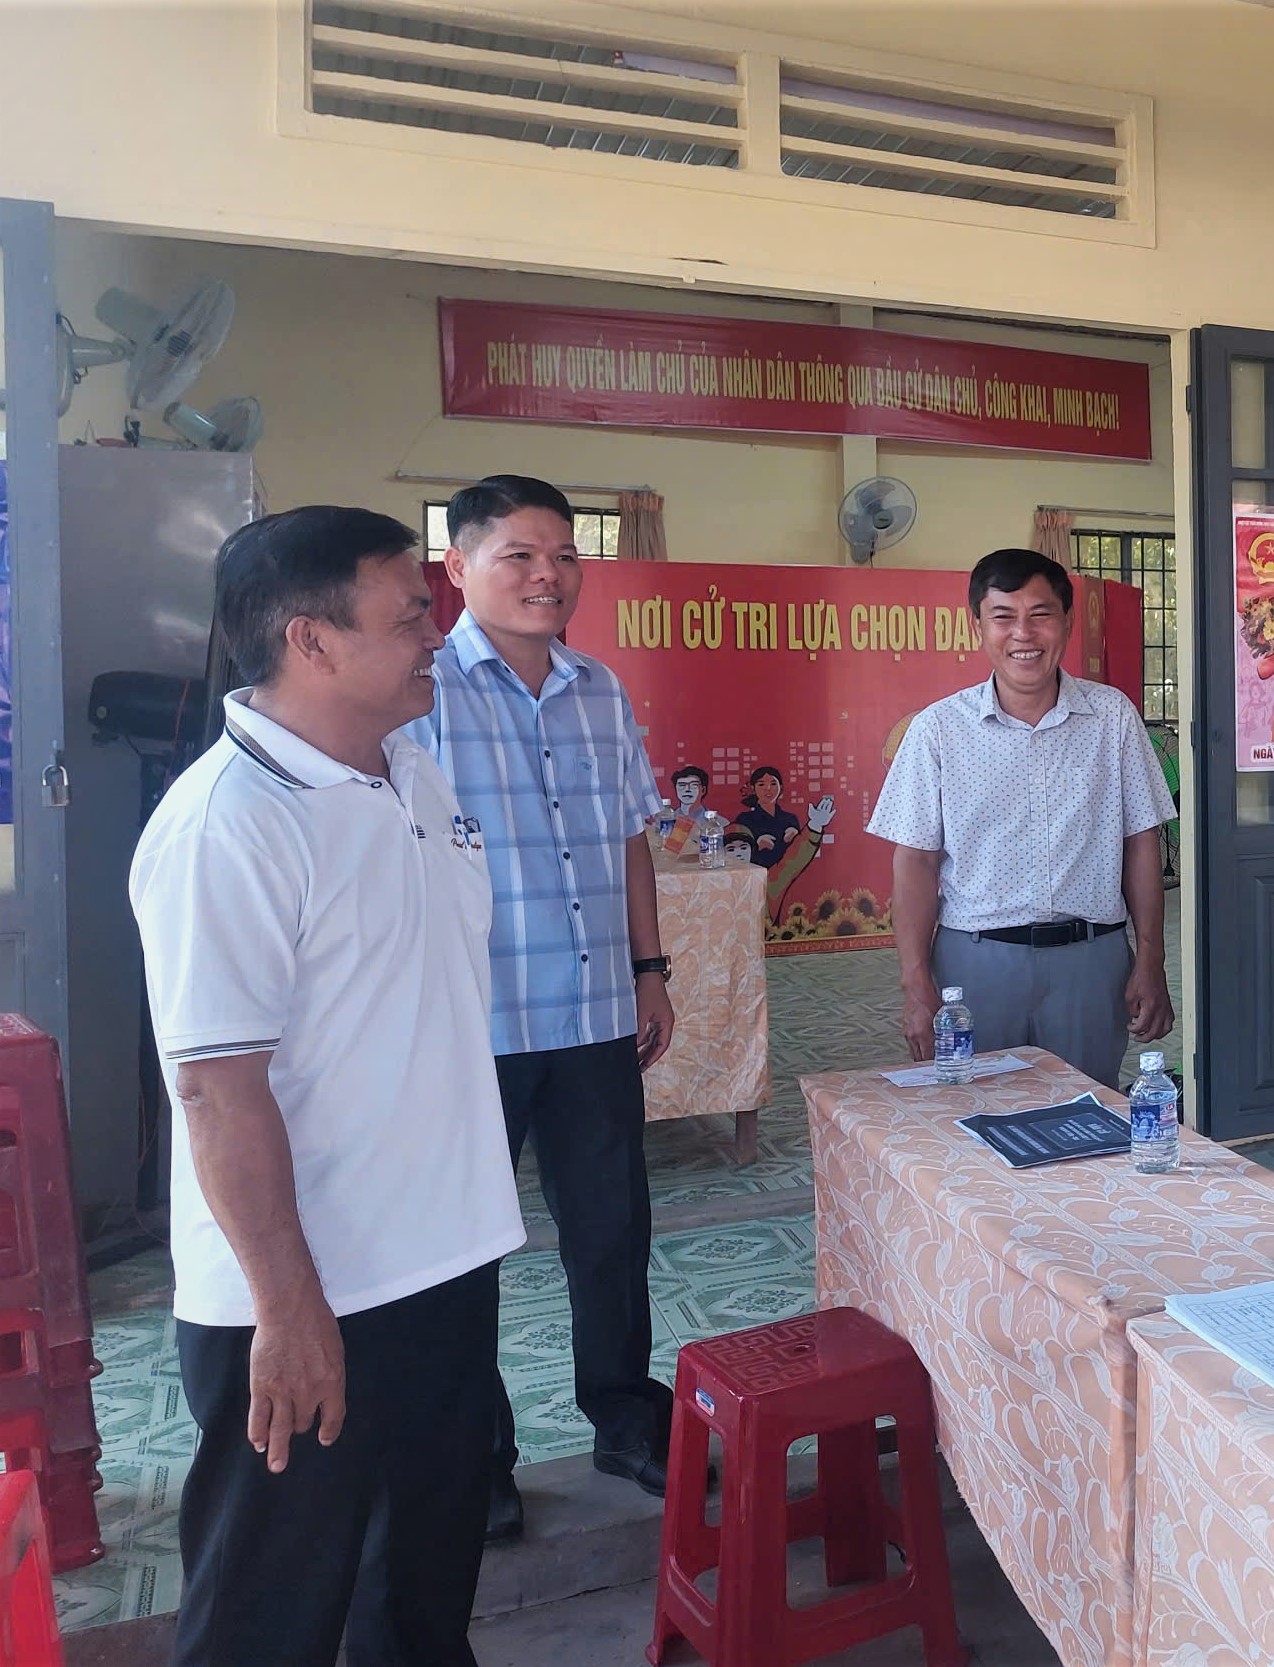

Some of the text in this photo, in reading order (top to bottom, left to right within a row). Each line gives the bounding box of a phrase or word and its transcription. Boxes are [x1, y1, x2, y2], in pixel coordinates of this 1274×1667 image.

[488, 333, 526, 386] PHÁT
[532, 344, 561, 387] HUY
[566, 334, 616, 393] QUYỀN
[620, 341, 652, 392] LÀM
[656, 340, 686, 395] CHỦ
[689, 341, 719, 397] CỦA
[722, 349, 763, 399] NHÂN
[766, 352, 796, 401] DÂN
[798, 354, 844, 404] THÔNG
[847, 364, 874, 410] QUA
[905, 358, 924, 410] CỬ
[925, 366, 951, 413] DÂN
[954, 364, 982, 420] CHỦ,
[985, 372, 1017, 420] CÔNG
[1020, 383, 1051, 428] KHAI,
[1053, 387, 1084, 427] MINH
[1086, 391, 1120, 436] BẠCH!
[617, 594, 672, 649] NƠI
[682, 584, 726, 650] CỬ
[731, 602, 778, 650] TRI
[787, 599, 842, 661] LỰA
[850, 603, 927, 662] CHỌN
